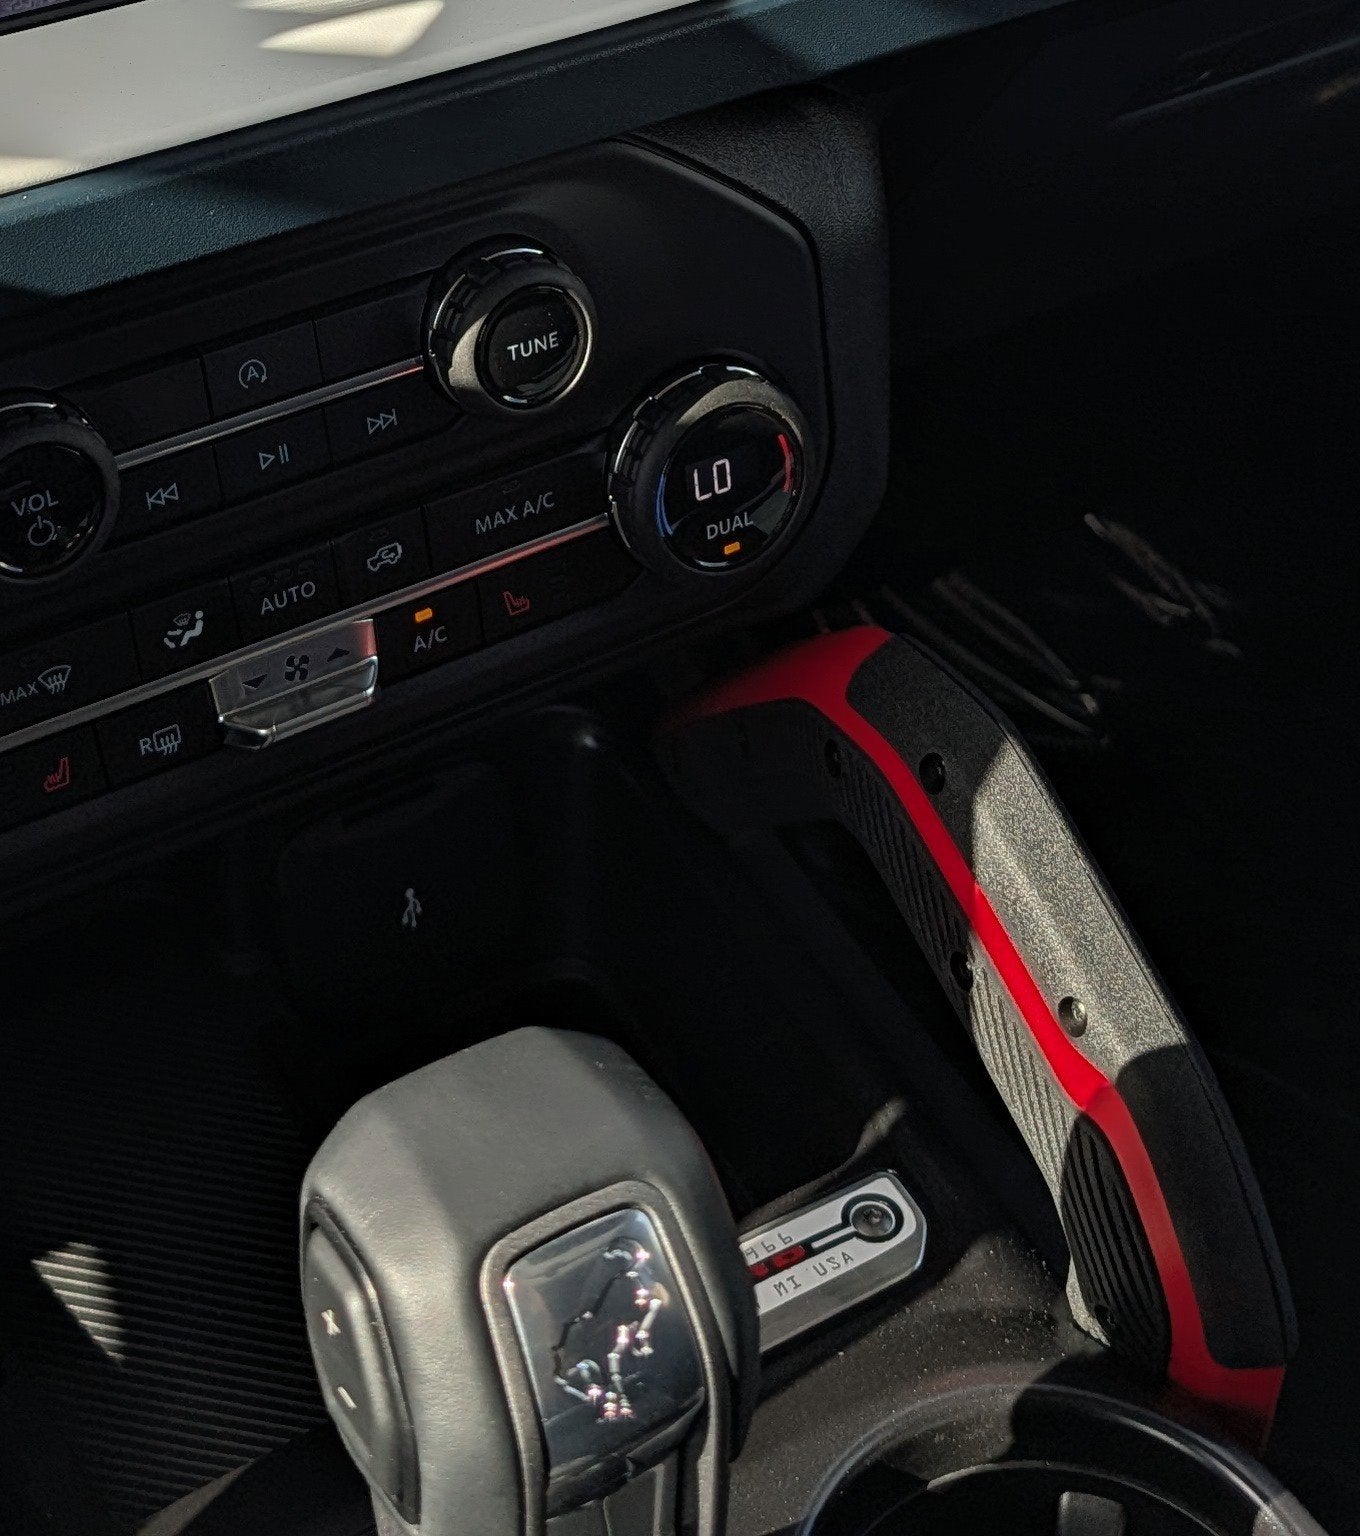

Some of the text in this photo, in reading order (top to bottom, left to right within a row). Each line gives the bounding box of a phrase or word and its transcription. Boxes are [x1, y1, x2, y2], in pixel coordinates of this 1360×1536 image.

[506, 331, 560, 362] TUNE
[691, 458, 733, 502] LO
[10, 488, 60, 520] VOL
[474, 489, 556, 535] MAX A/C
[705, 512, 754, 541] DUAL
[259, 579, 317, 616] AUTO
[413, 625, 448, 654] A/C
[0, 680, 38, 706] MAX
[773, 1251, 855, 1298] MI USA
